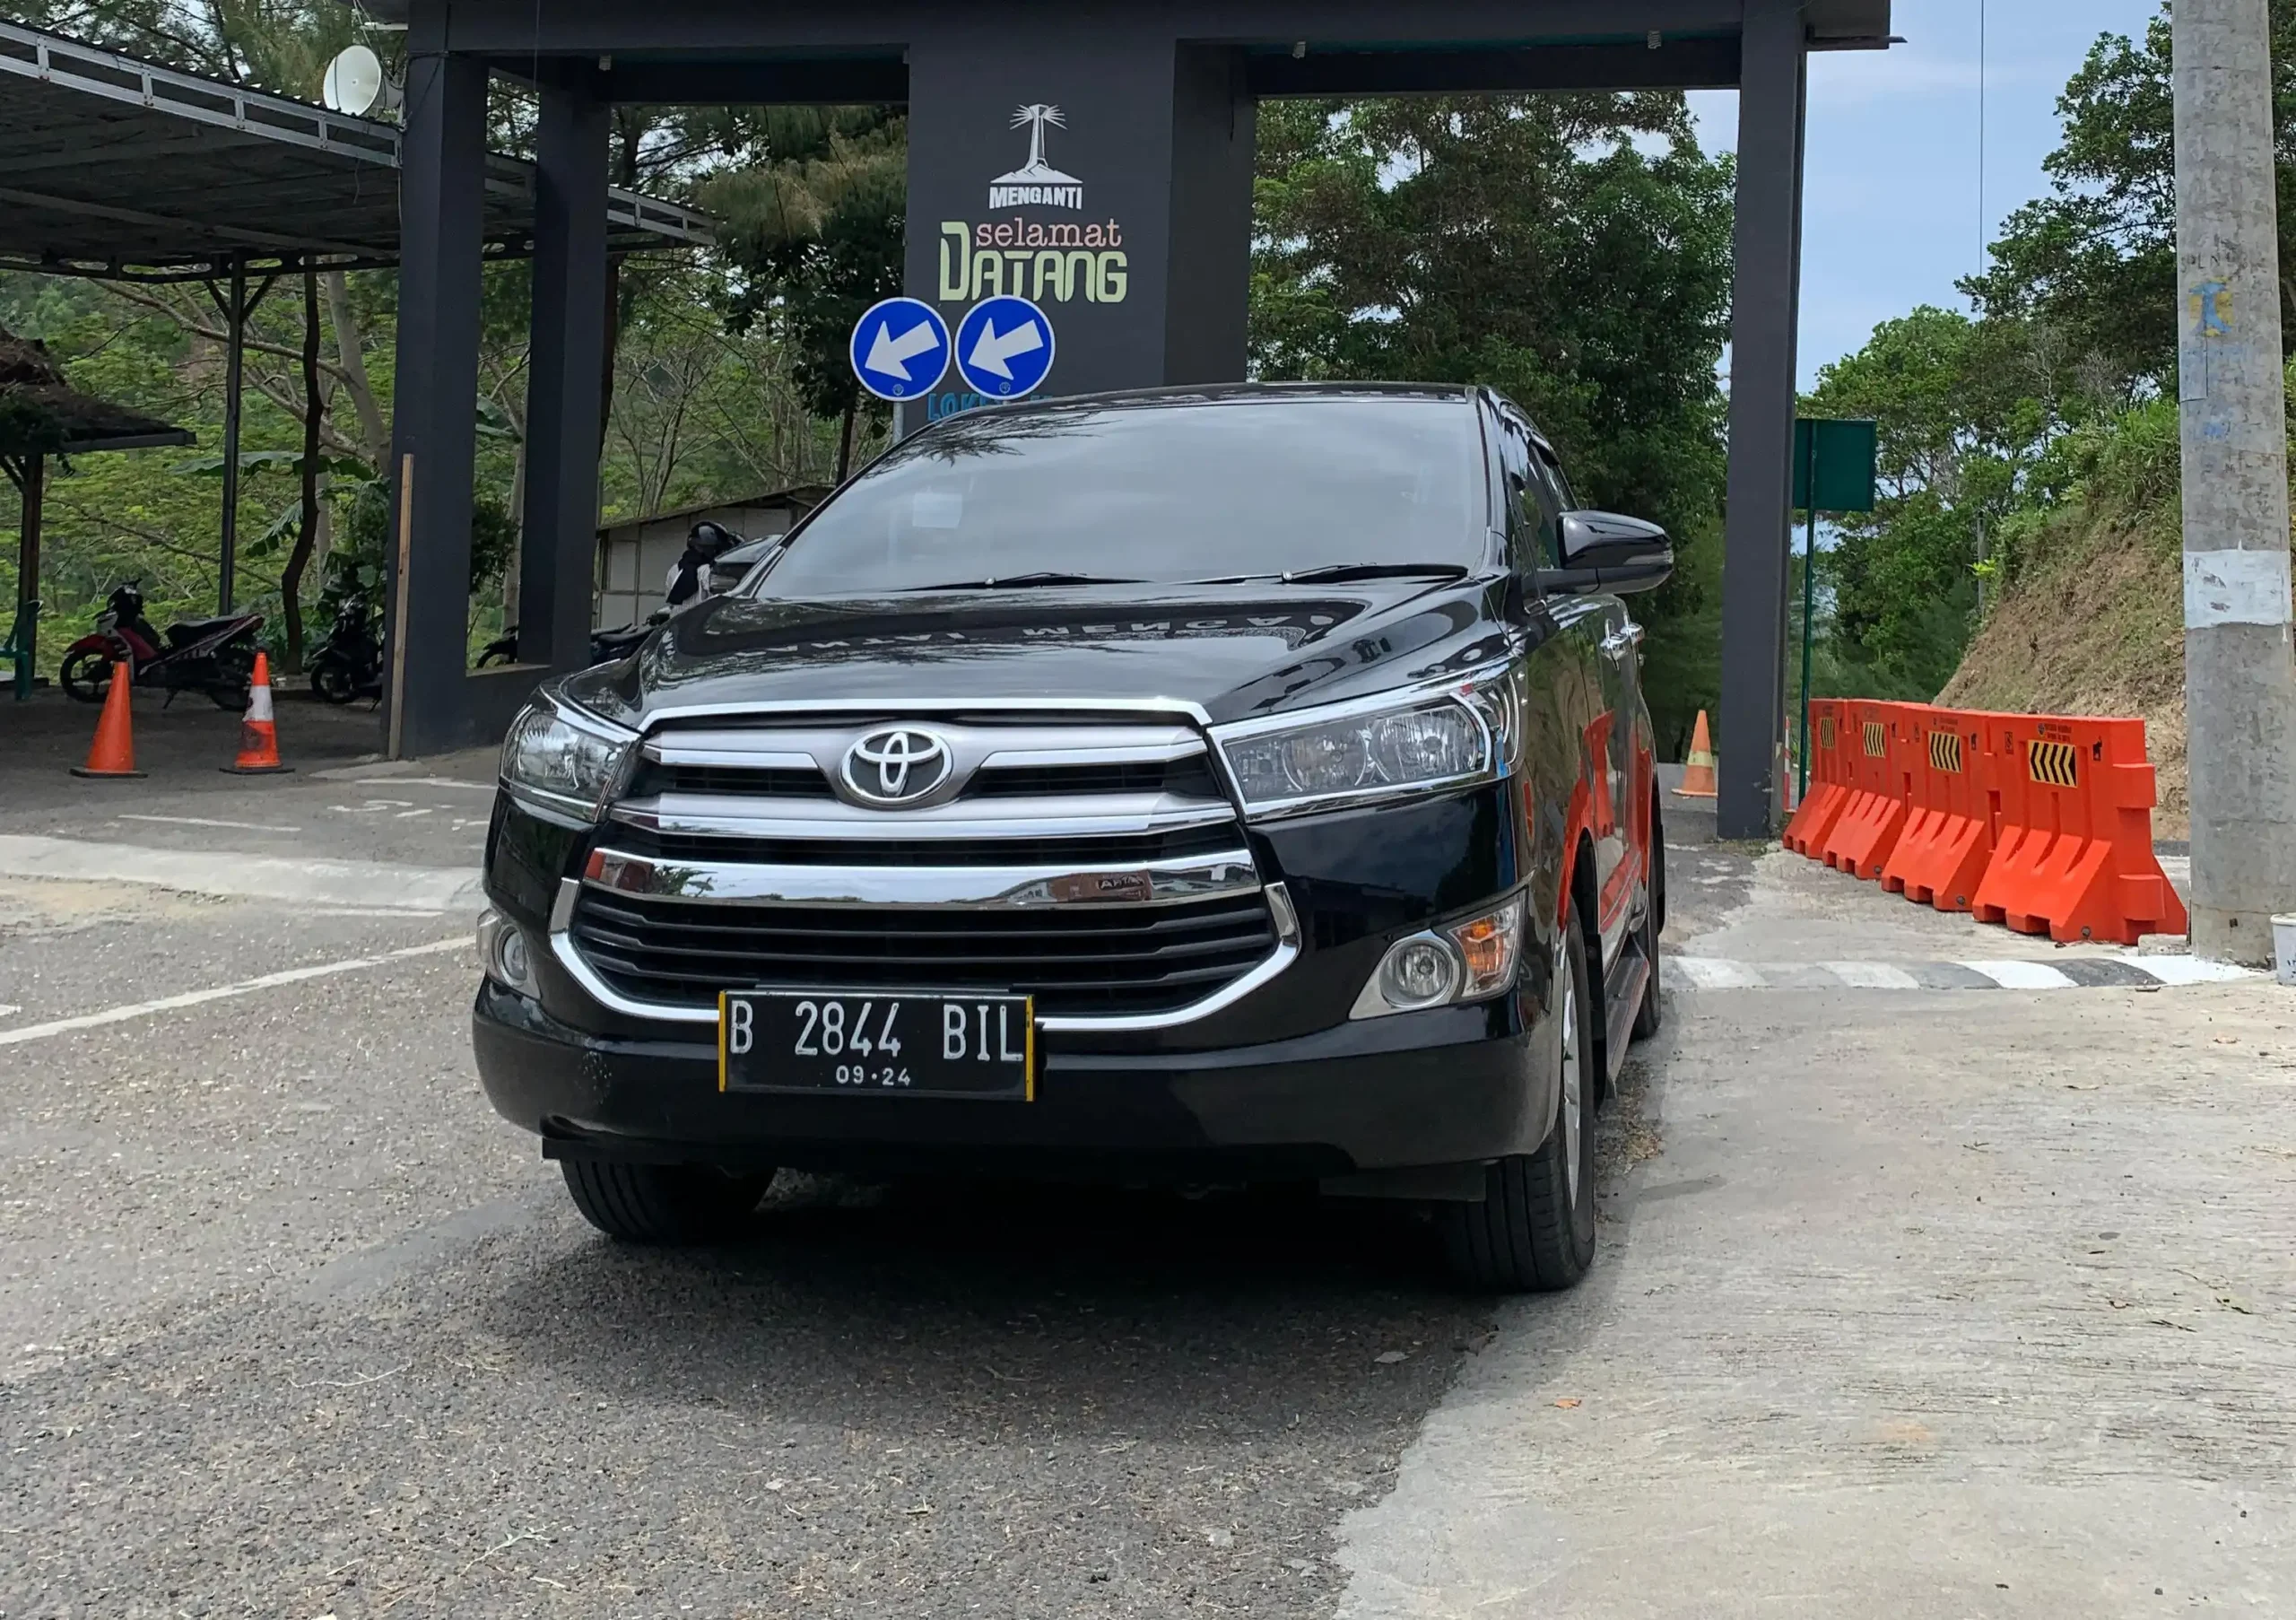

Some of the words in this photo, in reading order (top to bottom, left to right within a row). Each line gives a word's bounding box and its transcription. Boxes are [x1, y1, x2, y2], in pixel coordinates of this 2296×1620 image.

[989, 187, 1083, 209] MENGANTI
[976, 217, 1122, 247] selamat
[940, 222, 1127, 302] DATANG
[729, 999, 753, 1054] B
[795, 1000, 901, 1058] 2844
[943, 1004, 1024, 1061] BIL
